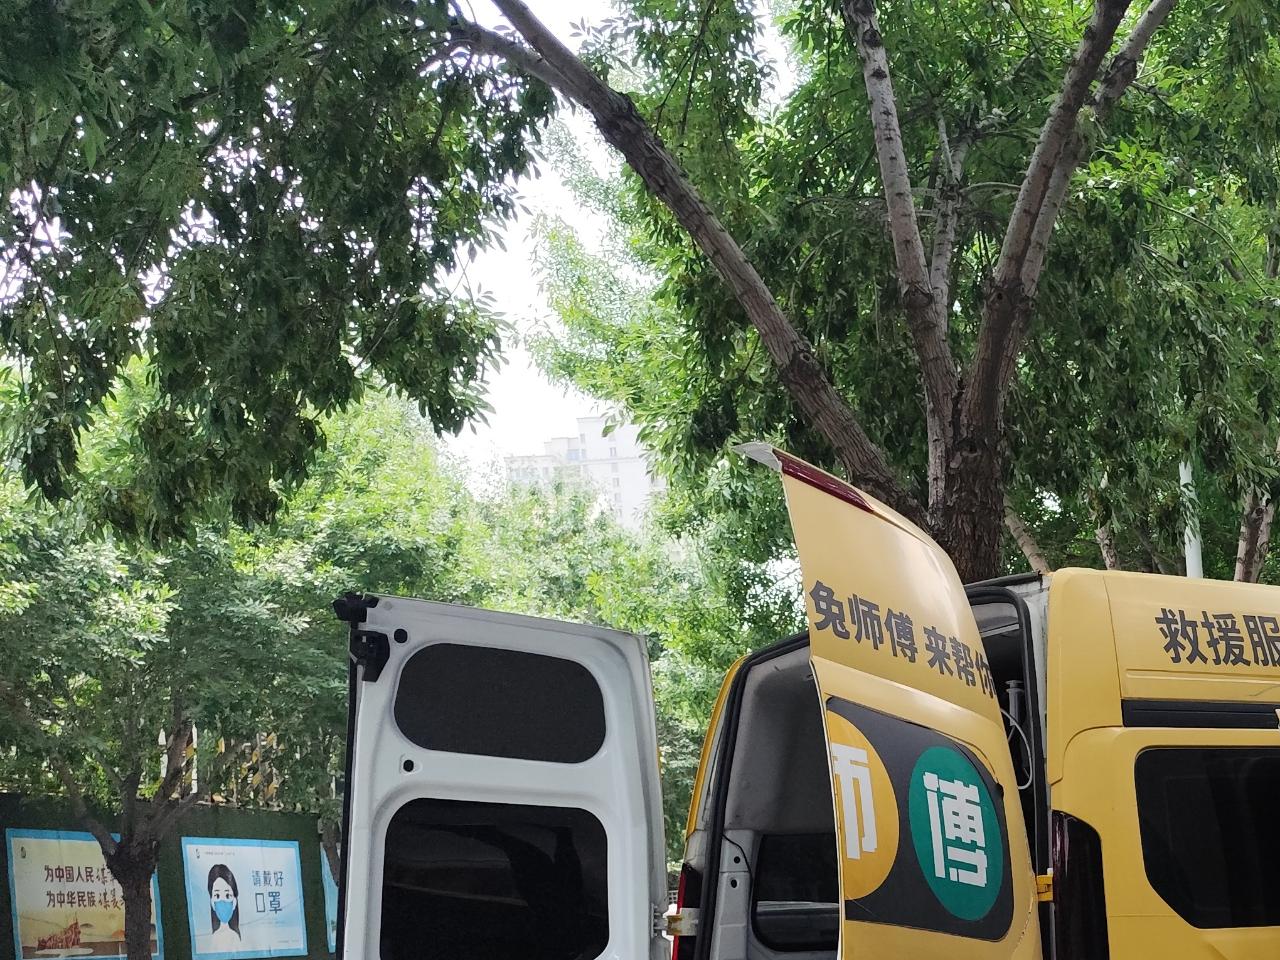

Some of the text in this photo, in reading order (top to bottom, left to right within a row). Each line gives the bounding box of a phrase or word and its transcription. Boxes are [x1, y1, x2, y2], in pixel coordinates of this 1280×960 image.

[809, 580, 919, 663] 兔师傅
[252, 870, 284, 888] 请戴好
[46, 888, 125, 911] 为中华民族谋复
[255, 891, 283, 914] 口罩
